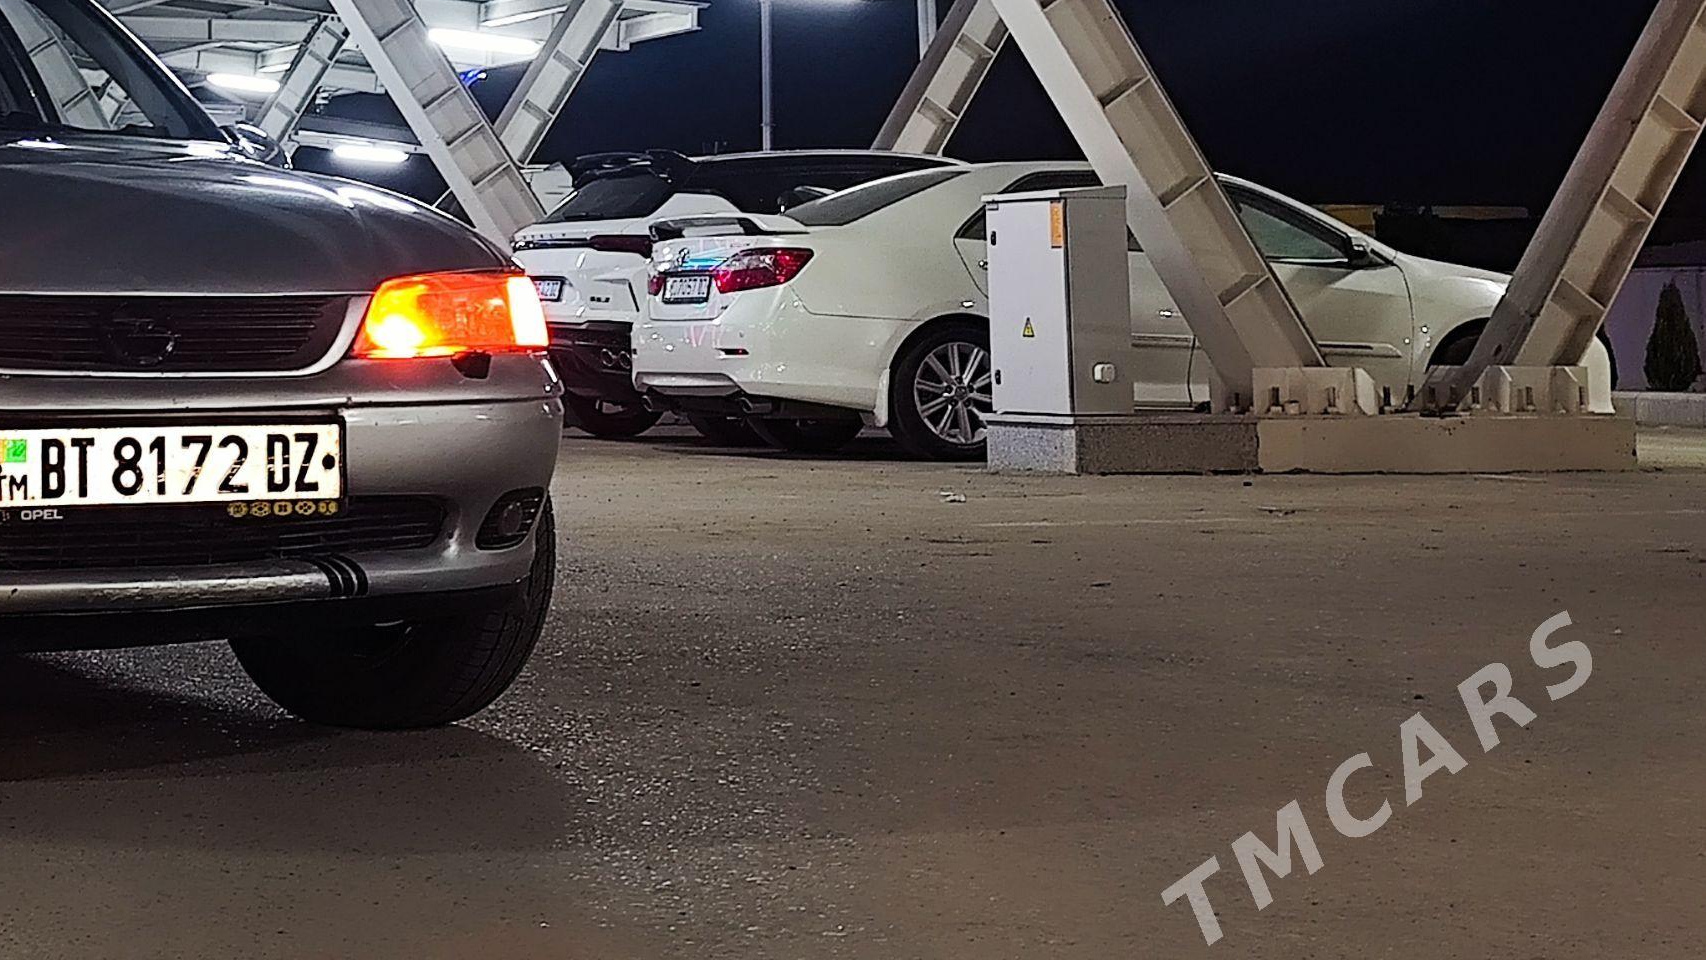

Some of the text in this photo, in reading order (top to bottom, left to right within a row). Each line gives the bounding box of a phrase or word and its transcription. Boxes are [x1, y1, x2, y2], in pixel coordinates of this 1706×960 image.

[41, 432, 319, 499] BT 8172 DZ
[20, 508, 64, 521] OPEL
